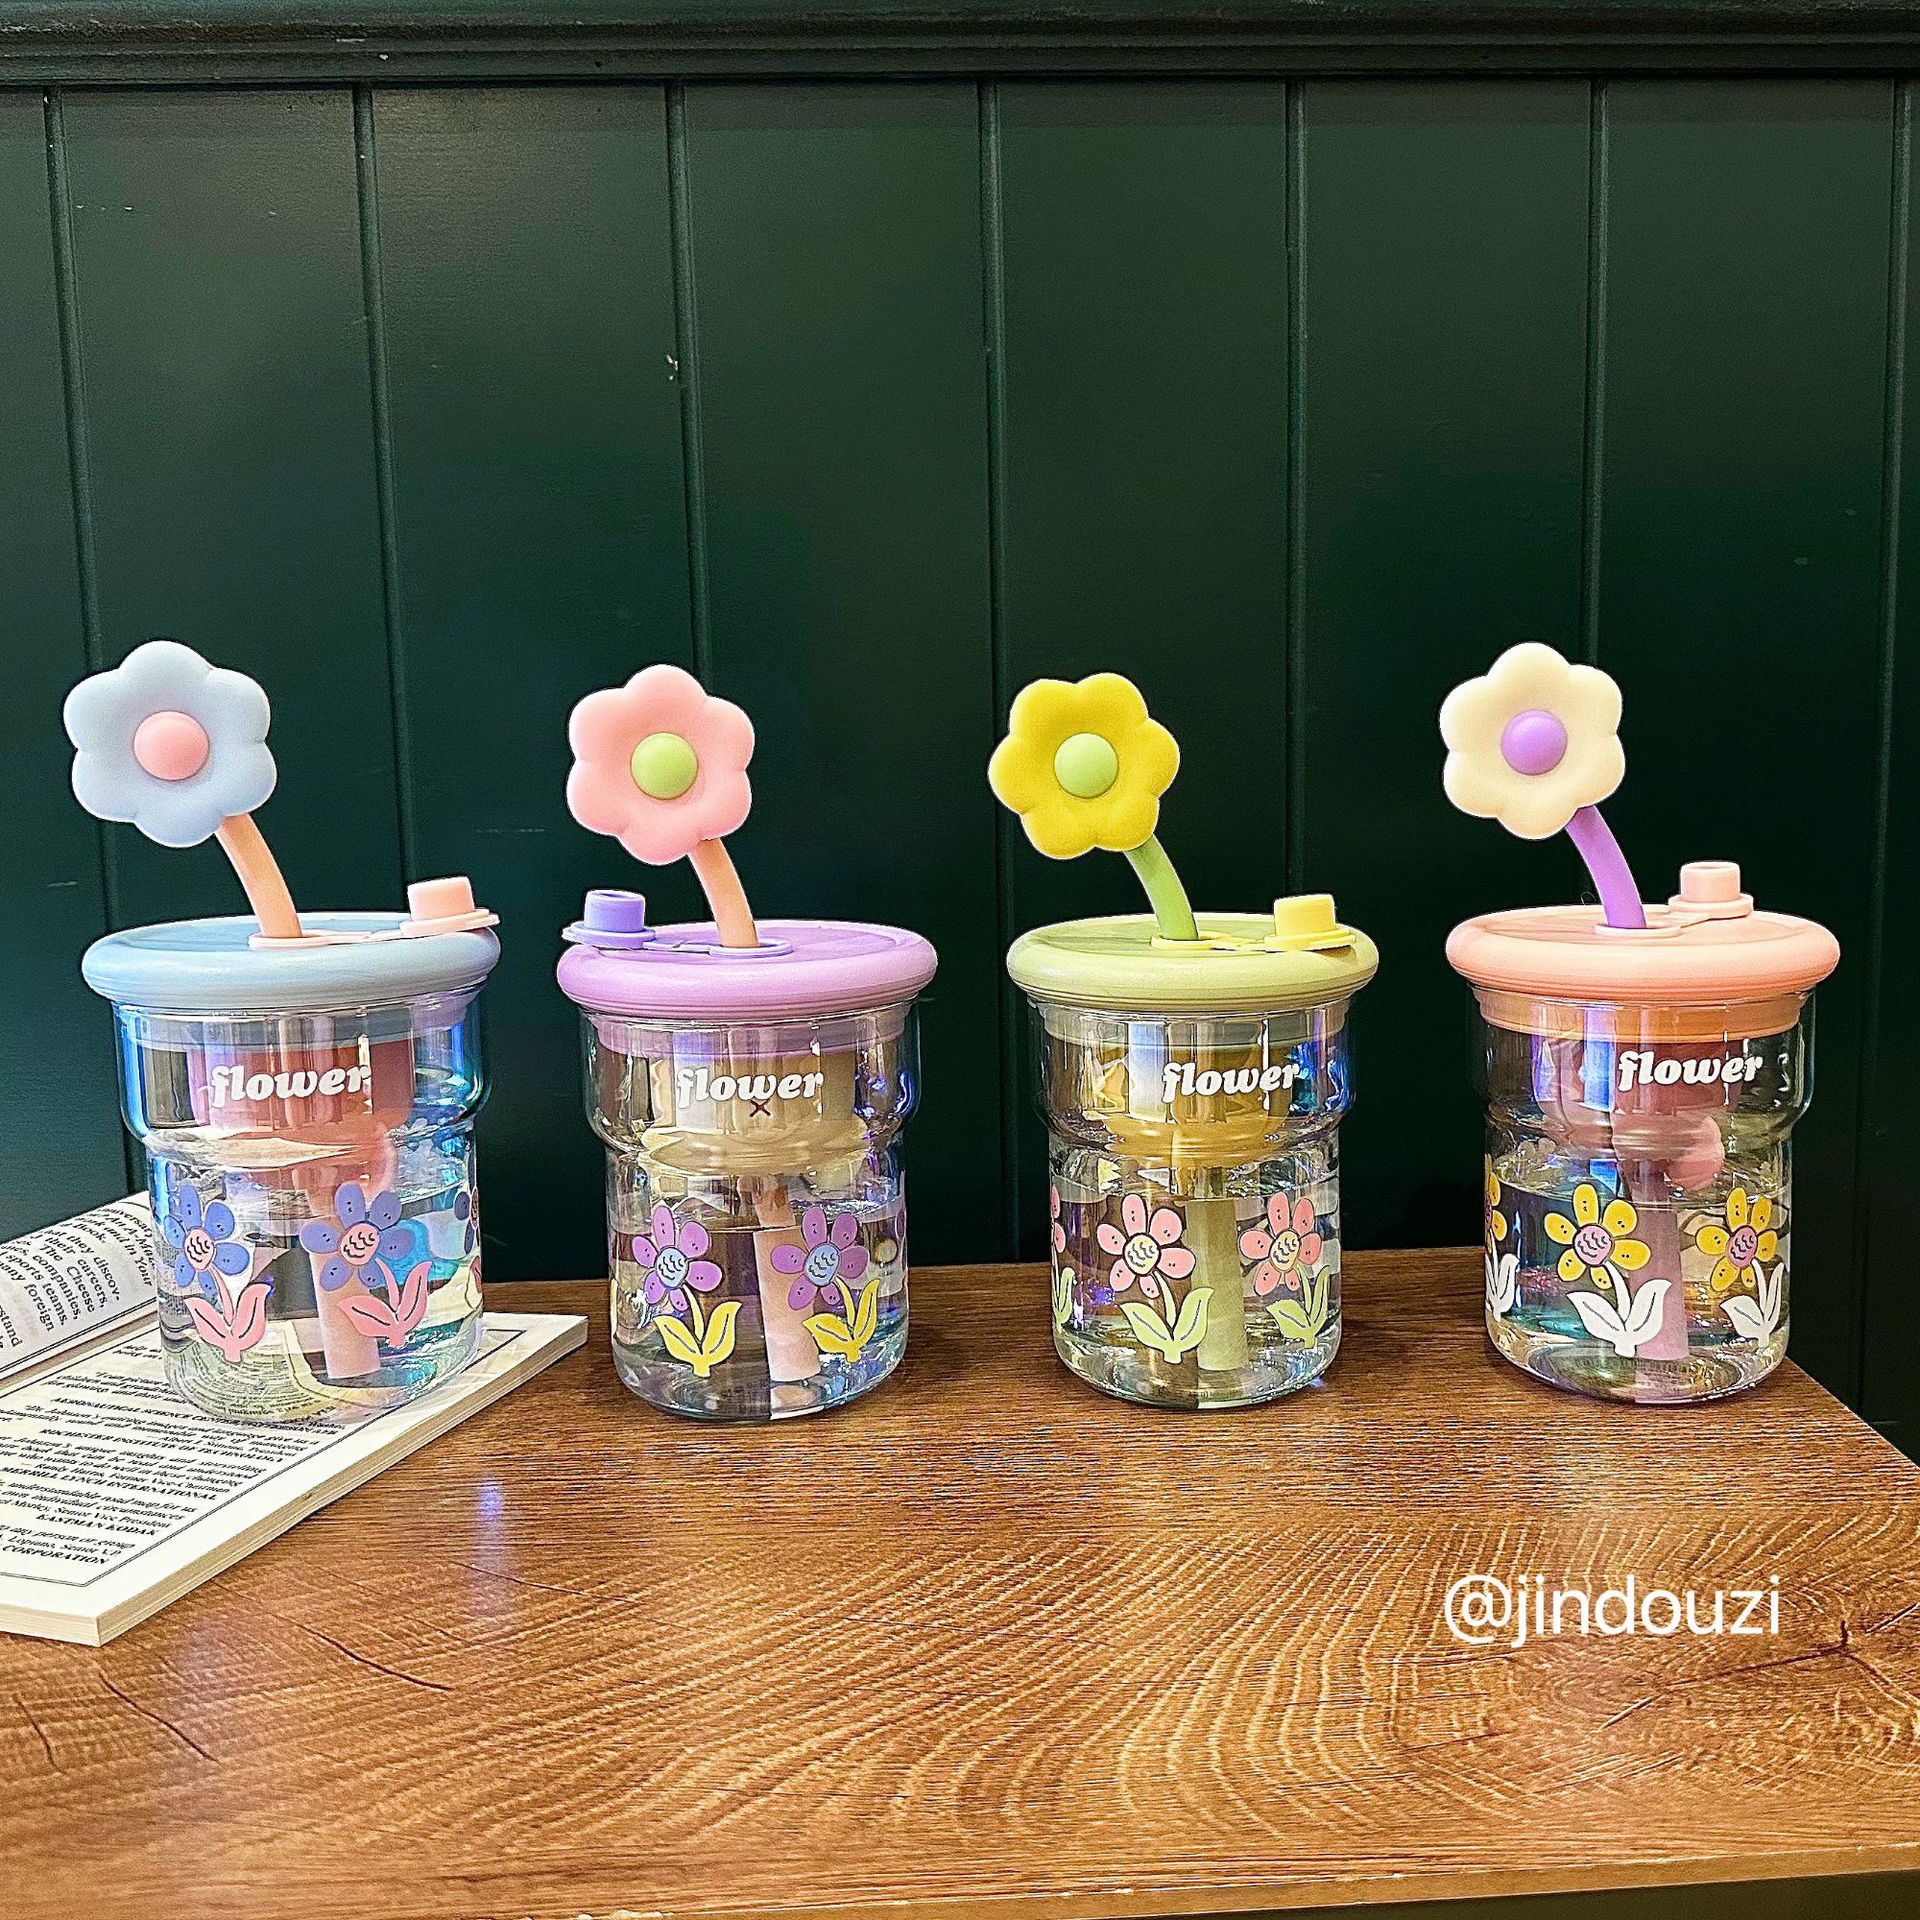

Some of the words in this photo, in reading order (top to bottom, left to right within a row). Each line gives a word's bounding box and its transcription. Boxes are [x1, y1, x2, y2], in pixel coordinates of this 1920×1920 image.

[209, 1064, 372, 1108] flower
[676, 1066, 824, 1110] flower
[1161, 1062, 1300, 1104] flower
[1617, 1050, 1764, 1093] flower
[32, 1254, 82, 1320] companies,
[39, 1244, 63, 1262] The
[66, 1265, 96, 1313] Cheese
[44, 1237, 76, 1255] their
[77, 1258, 108, 1308] careers,
[66, 1236, 95, 1254] they
[93, 1256, 120, 1300] discov-
[6, 1254, 45, 1280] sports
[42, 1282, 68, 1326] teams.
[24, 1283, 55, 1332] foreign
[0, 1467, 57, 1479] MERRILL
[60, 1475, 107, 1485] LYNCH
[106, 1481, 216, 1500] INTERNATIONAL
[32, 1531, 79, 1541] person
[36, 1514, 102, 1528] EASTMAN
[105, 1524, 155, 1535] KODAK
[54, 1506, 91, 1517] Senior
[94, 1512, 117, 1521] Vice
[119, 1516, 170, 1527] President
[2, 1545, 108, 1564] CORPORATION
[60, 1544, 98, 1553] Senior
